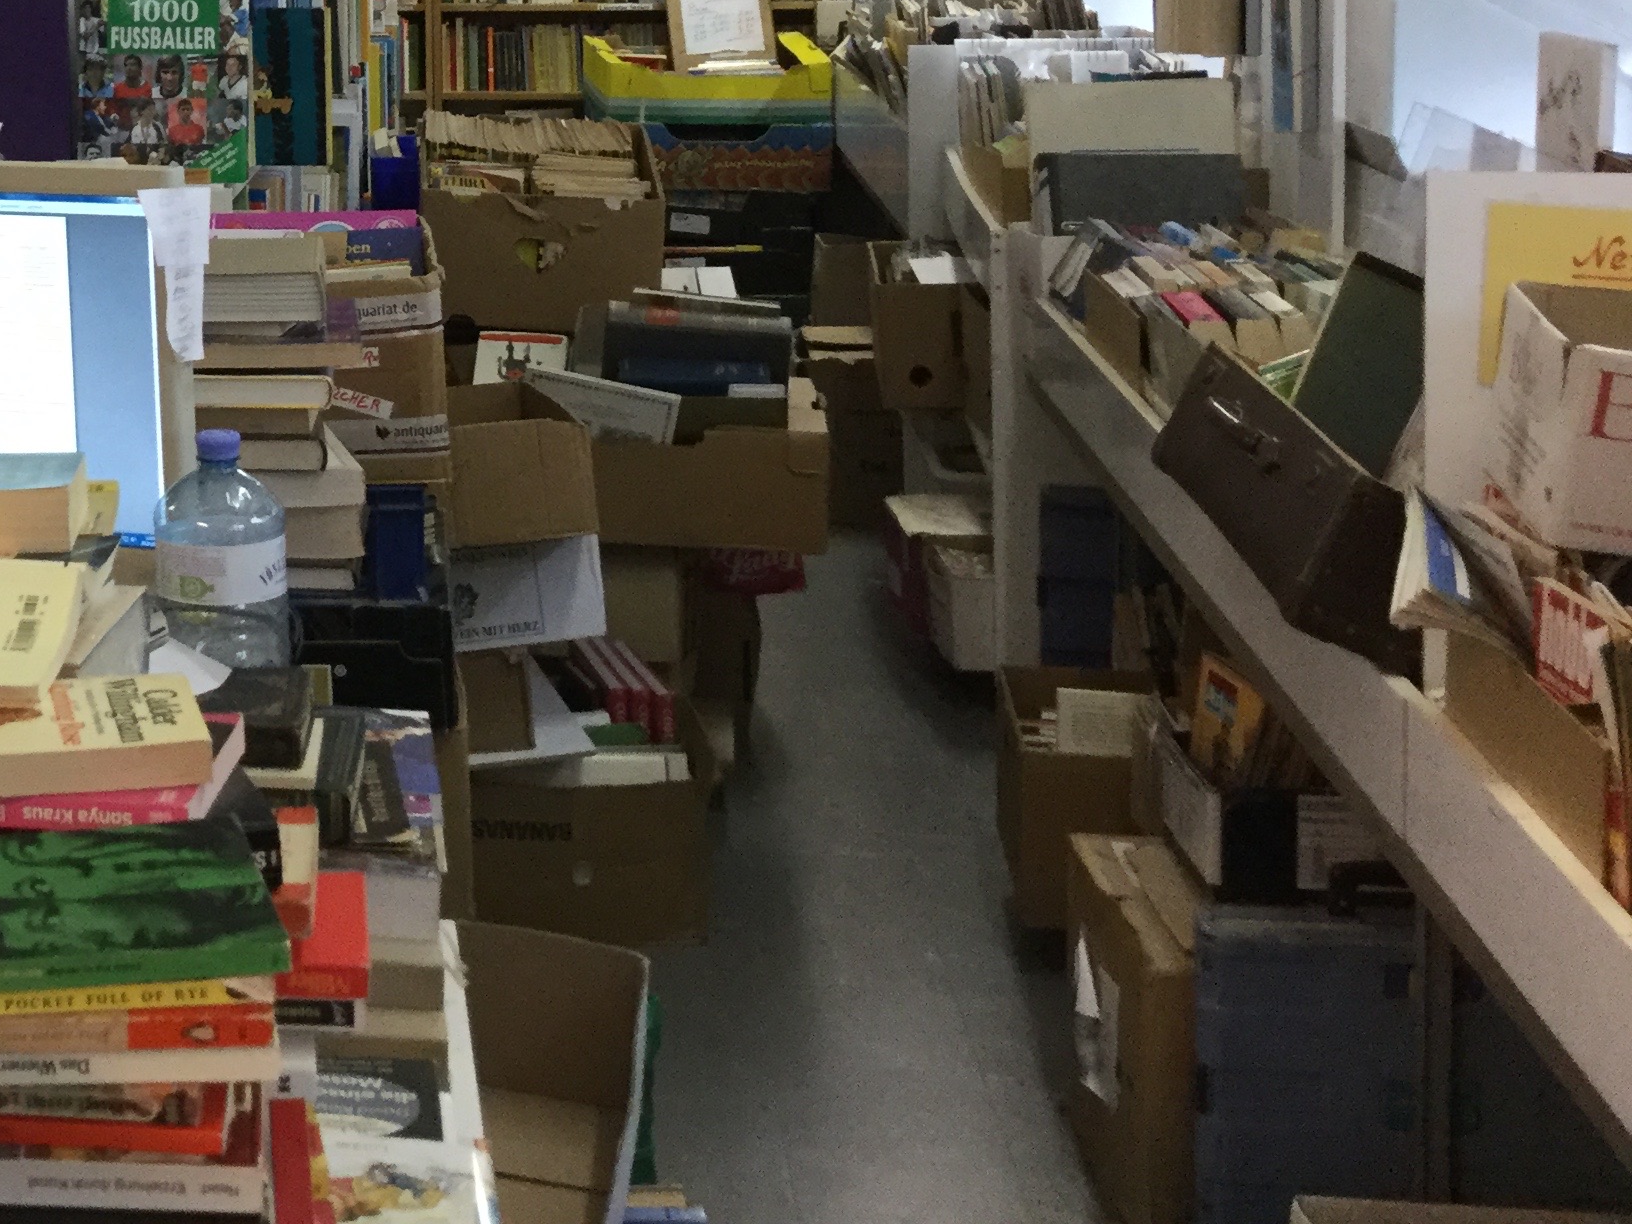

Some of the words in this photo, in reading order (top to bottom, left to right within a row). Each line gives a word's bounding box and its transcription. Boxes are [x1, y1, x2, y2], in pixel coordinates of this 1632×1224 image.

[129, 0, 199, 23] 1000
[110, 26, 216, 50] FUSSBALLER
[140, 989, 164, 1003] OF
